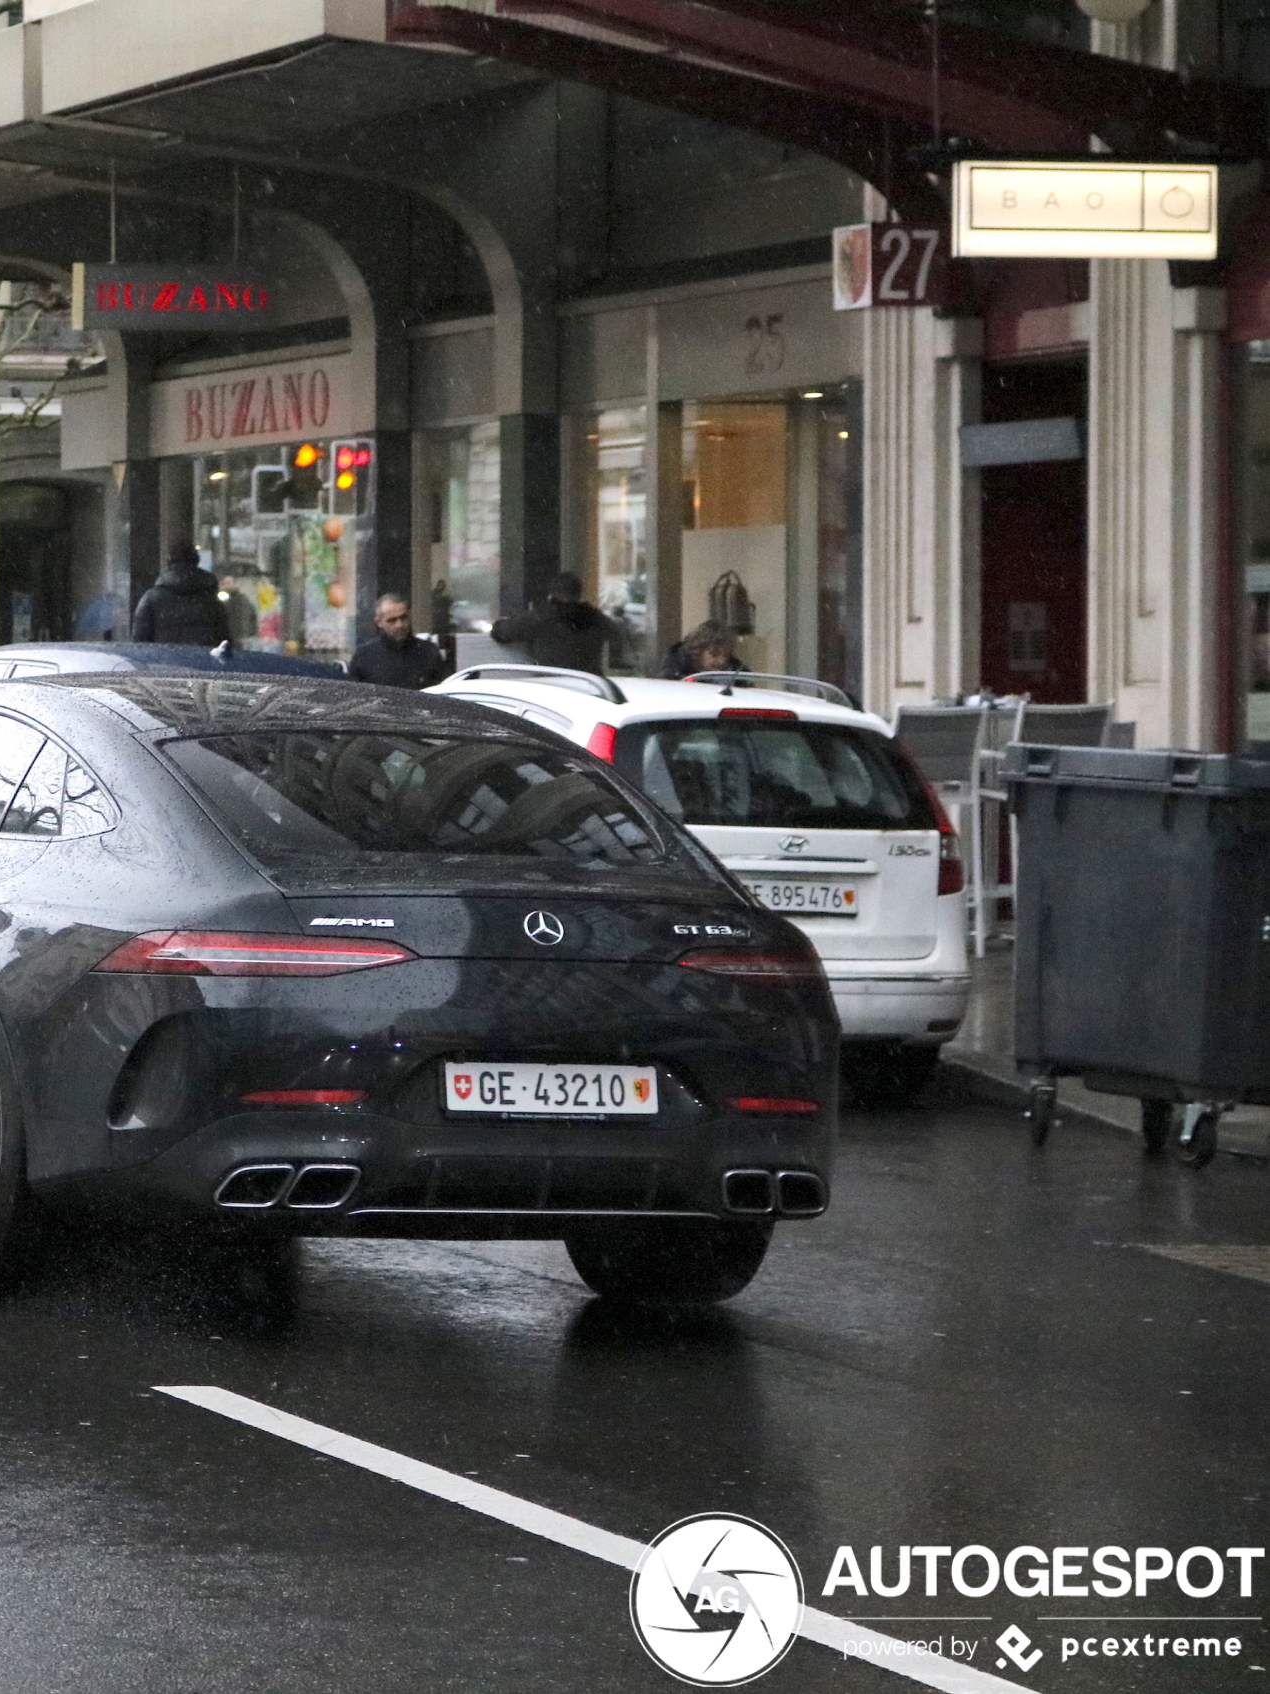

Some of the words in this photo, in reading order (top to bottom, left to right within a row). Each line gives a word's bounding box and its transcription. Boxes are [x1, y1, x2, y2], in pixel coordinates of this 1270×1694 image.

[879, 228, 940, 300] 27
[673, 925, 700, 935] GT
[705, 925, 733, 935] 63
